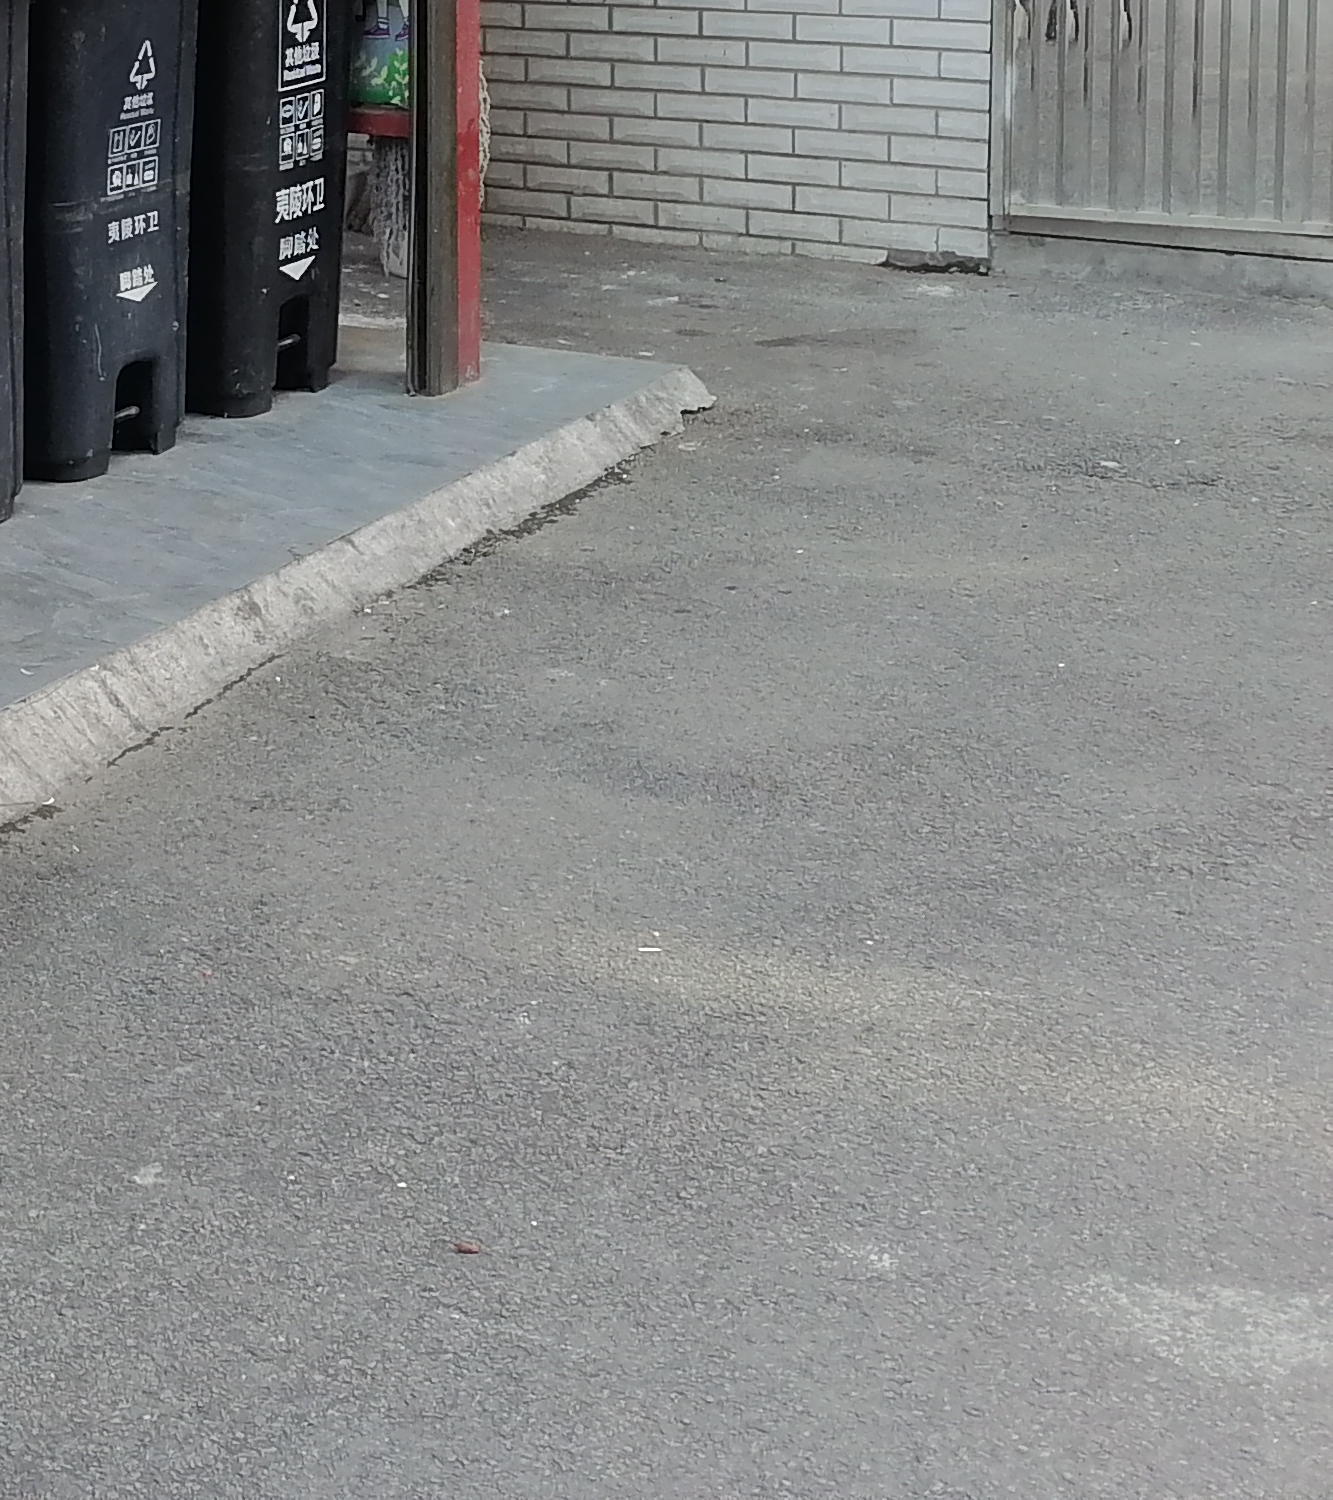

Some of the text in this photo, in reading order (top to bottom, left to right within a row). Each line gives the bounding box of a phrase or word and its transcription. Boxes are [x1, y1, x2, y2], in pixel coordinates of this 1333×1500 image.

[274, 177, 324, 223] 夷陵环卫
[107, 211, 160, 244] 夷陵环卫
